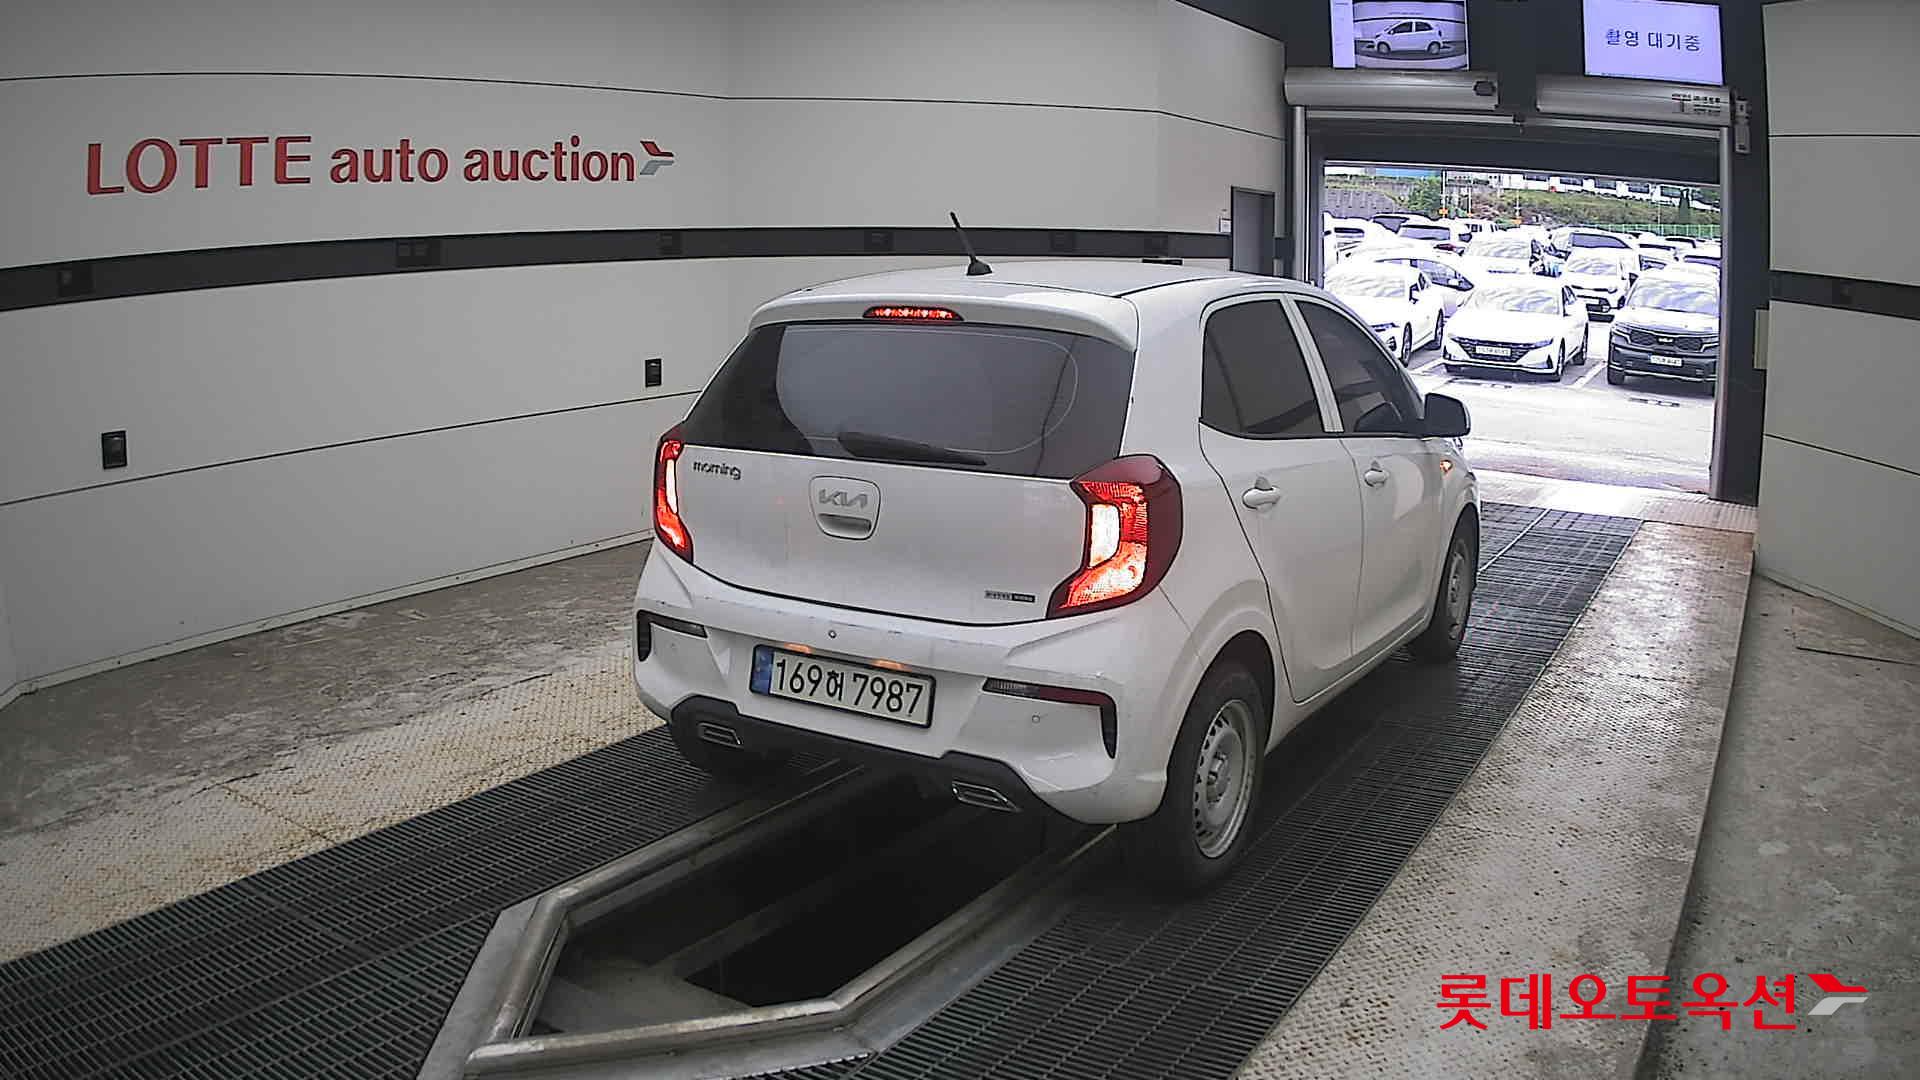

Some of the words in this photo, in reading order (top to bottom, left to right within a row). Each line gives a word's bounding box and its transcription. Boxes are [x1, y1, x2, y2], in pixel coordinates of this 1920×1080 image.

[1647, 32, 1700, 51] 대기중
[87, 136, 311, 195] LOTTE
[330, 139, 449, 185] auto
[463, 135, 635, 183] auction
[692, 460, 741, 481] morning
